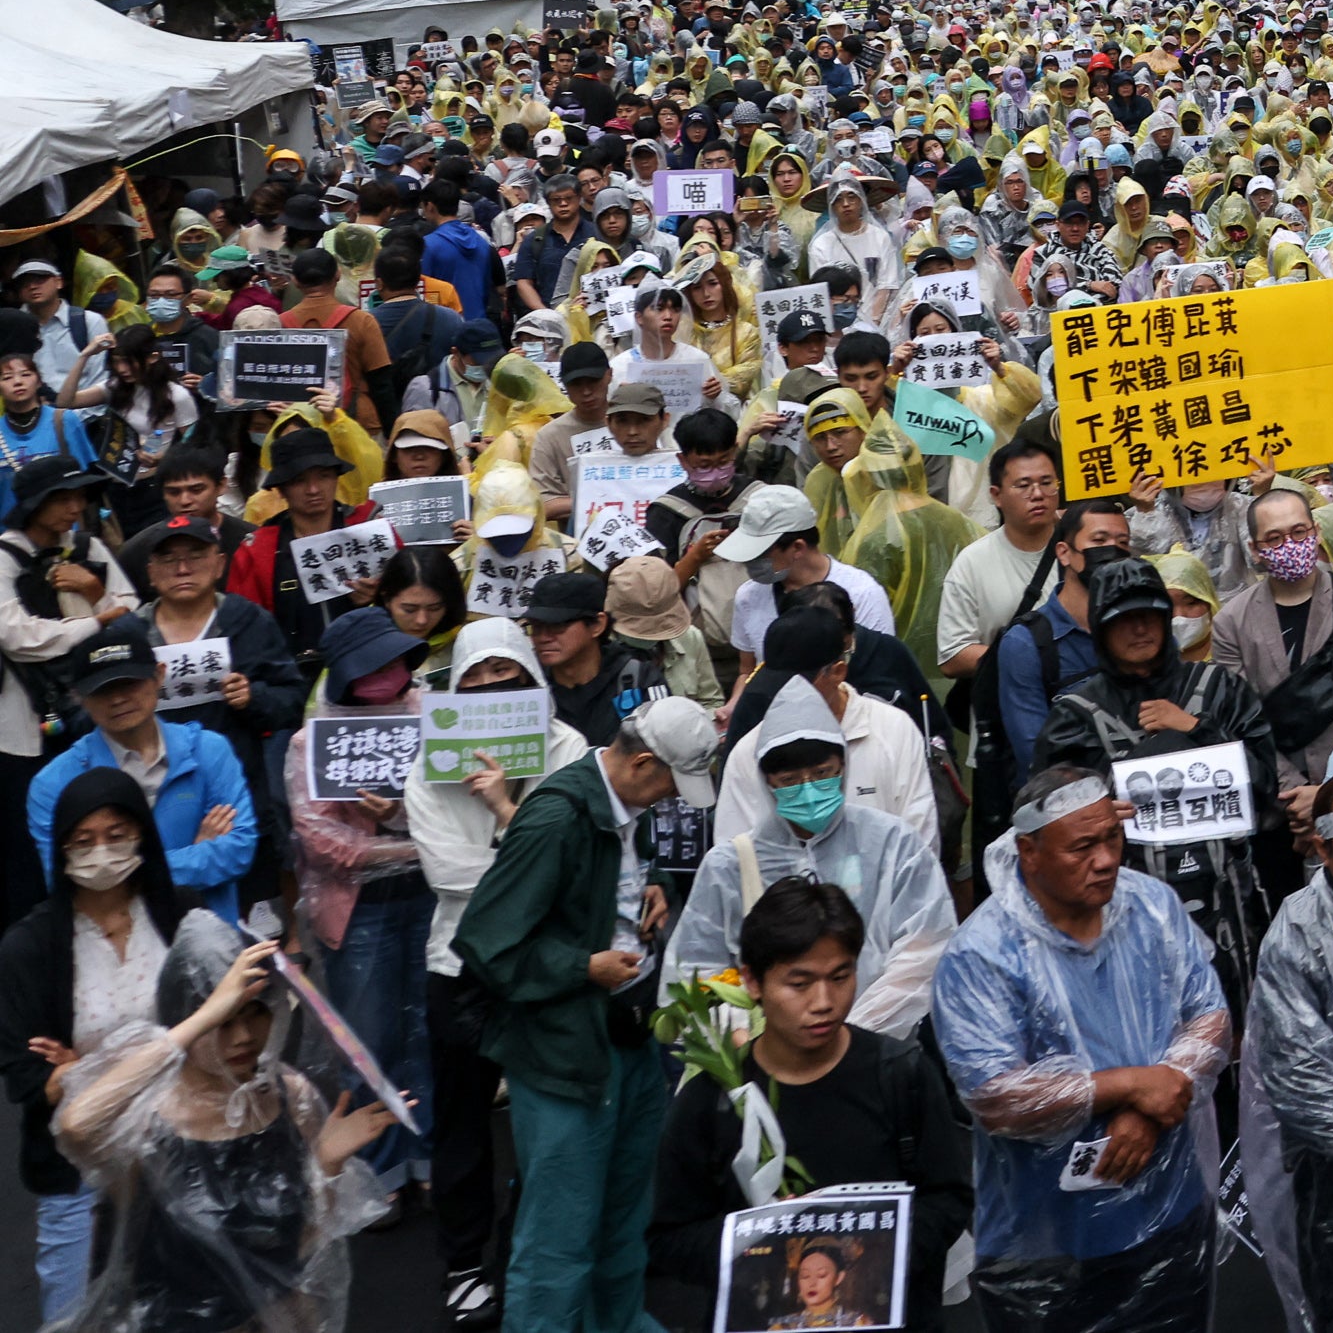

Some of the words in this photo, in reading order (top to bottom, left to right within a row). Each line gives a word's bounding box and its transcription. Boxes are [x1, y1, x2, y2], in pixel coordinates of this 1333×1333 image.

[682, 180, 707, 204] 喵
[760, 294, 825, 317] 退回法案
[1063, 296, 1238, 358] 罷免傅昆萁
[913, 336, 982, 360] 退回法案
[912, 360, 982, 384] 實質審查
[1070, 348, 1243, 403] 下架韓國瑜
[904, 410, 961, 436] TAIWAN
[1076, 390, 1252, 449] 下架黃國昌
[1078, 422, 1293, 491] 罷免徐巧芯
[301, 532, 390, 568] 退回法案
